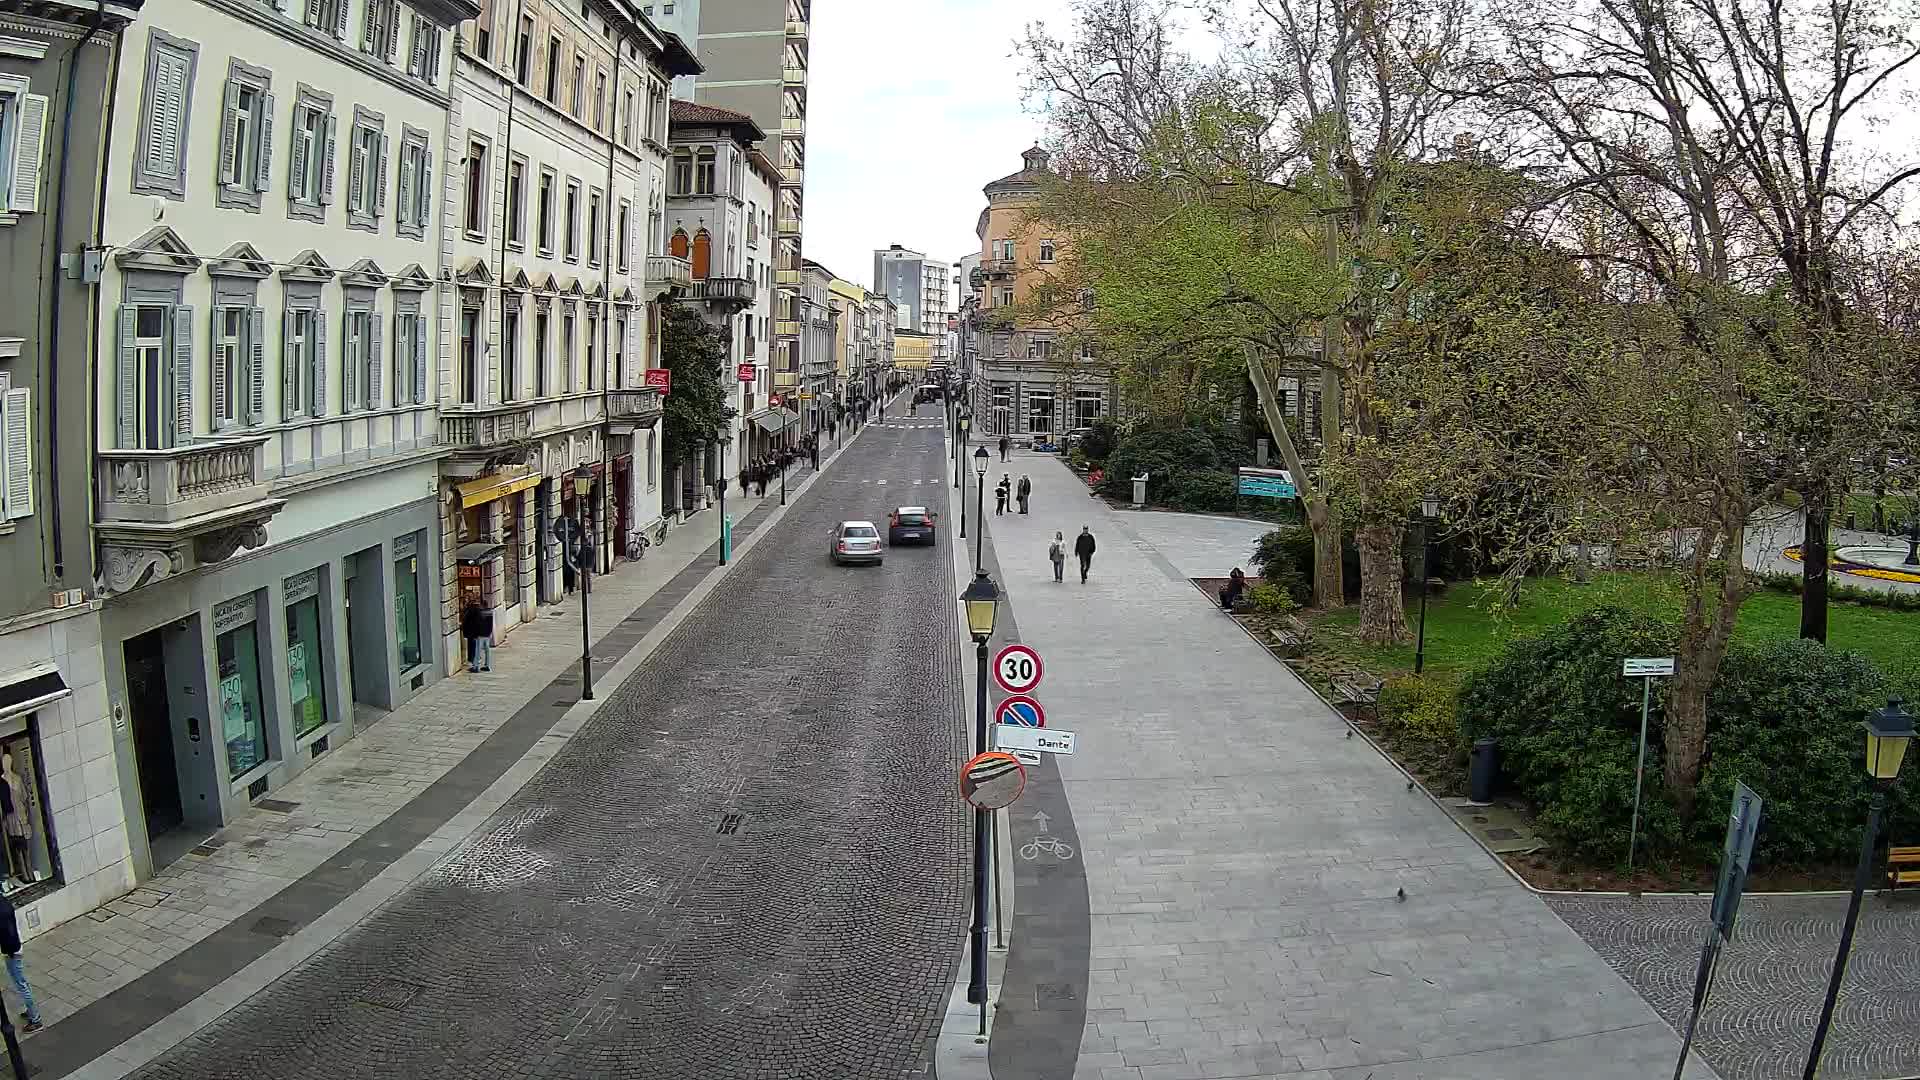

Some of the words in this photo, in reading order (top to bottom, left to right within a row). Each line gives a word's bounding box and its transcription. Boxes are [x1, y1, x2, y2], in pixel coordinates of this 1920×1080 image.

[1005, 658, 1032, 680] 30
[221, 677, 240, 701] 130
[1038, 739, 1069, 749] Dante
